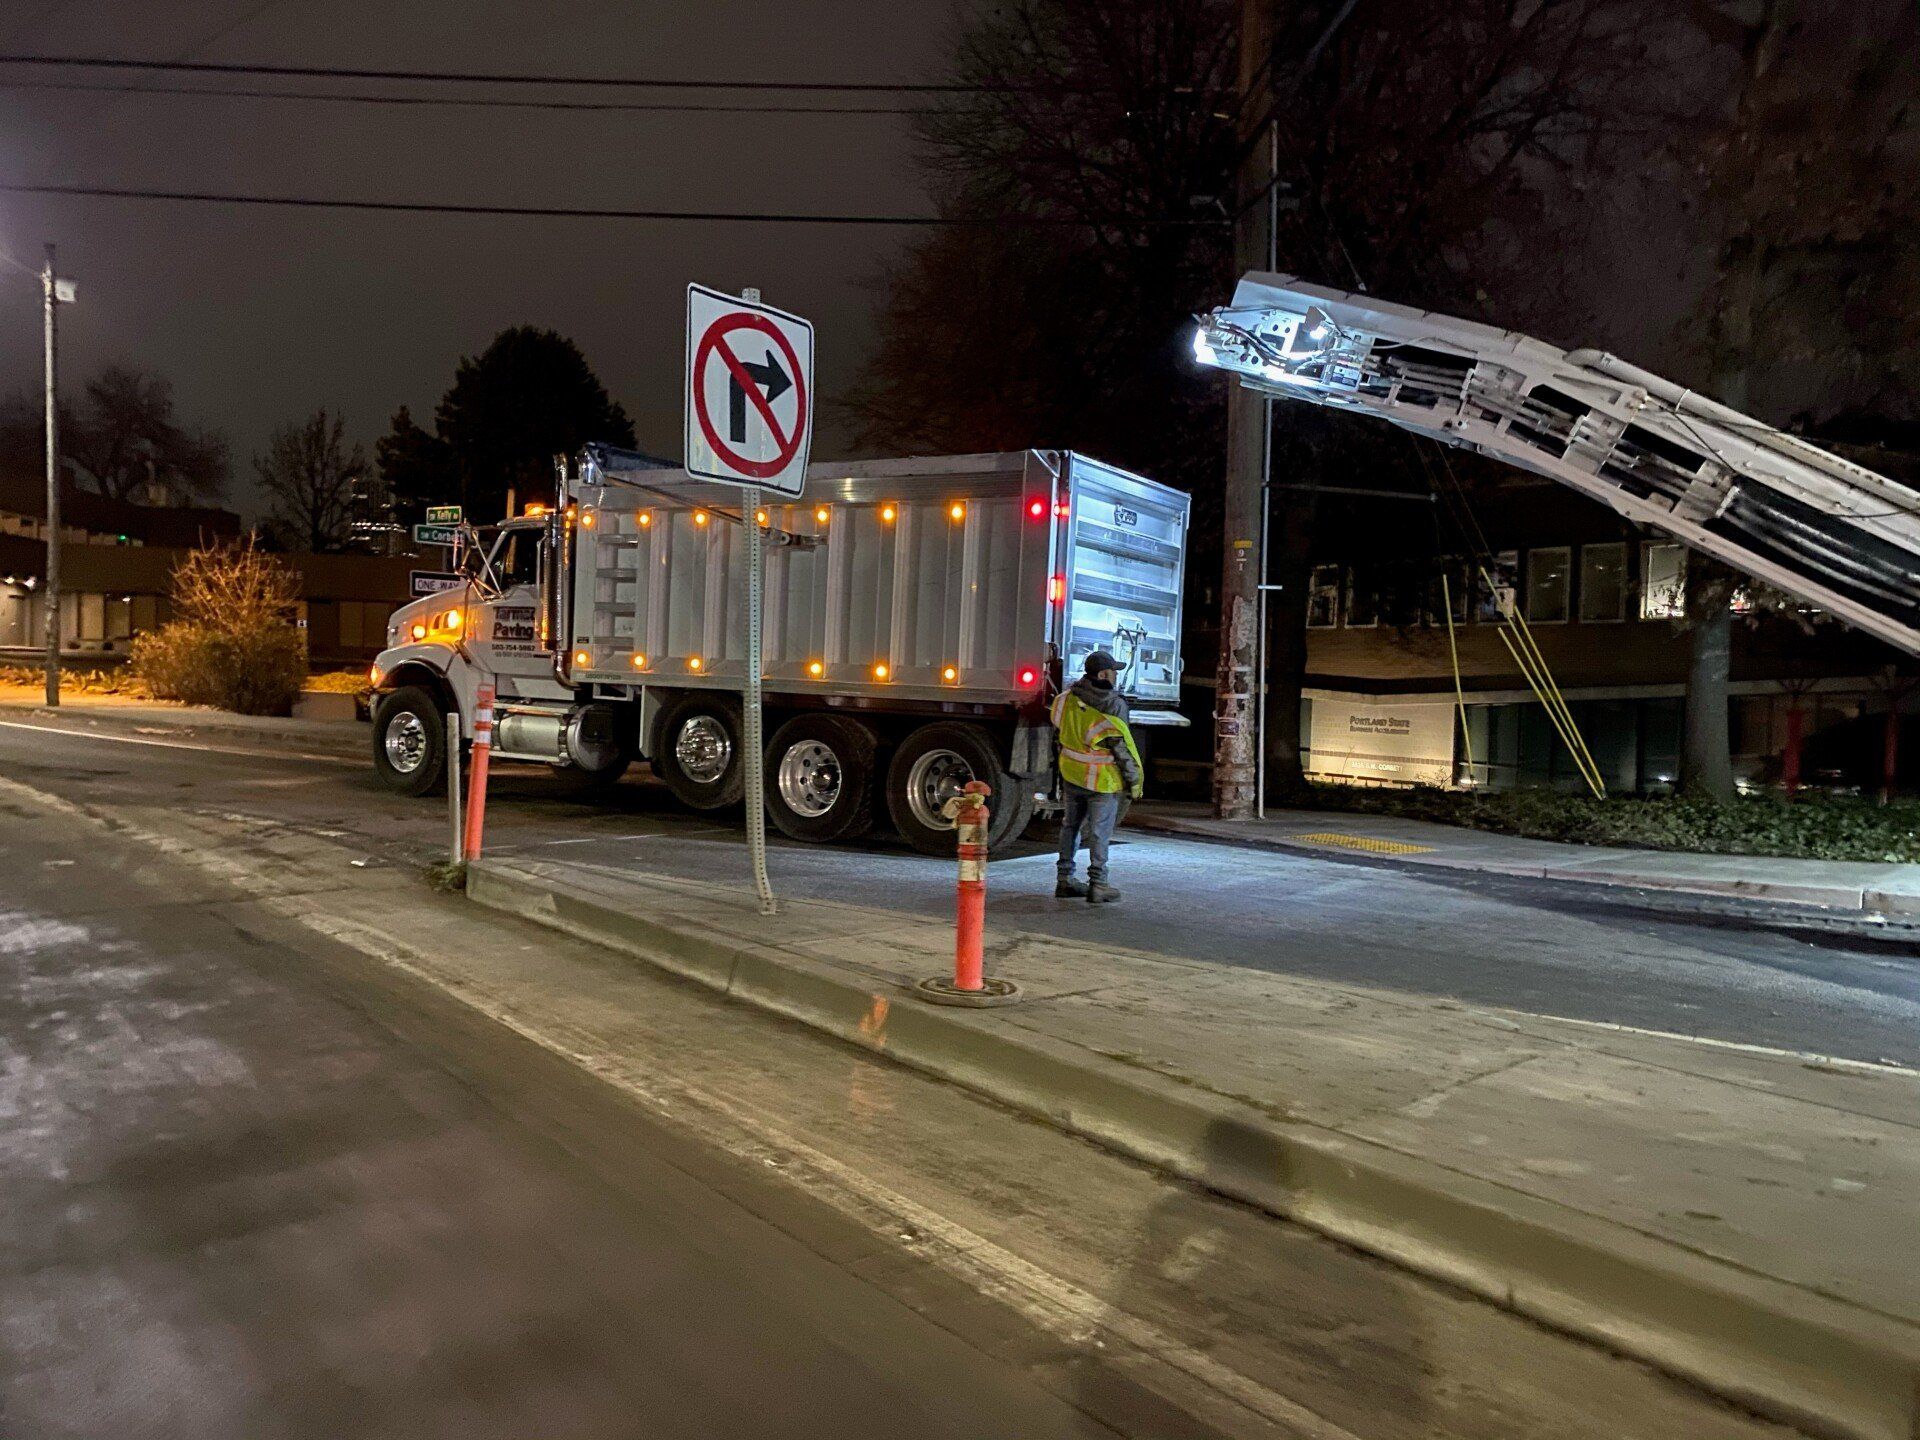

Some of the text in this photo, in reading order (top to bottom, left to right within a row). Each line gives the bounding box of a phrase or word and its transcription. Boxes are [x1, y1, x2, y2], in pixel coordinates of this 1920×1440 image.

[1238, 548, 1245, 557] 9
[417, 579, 461, 590] ONE WAY
[493, 622, 535, 640] Paving
